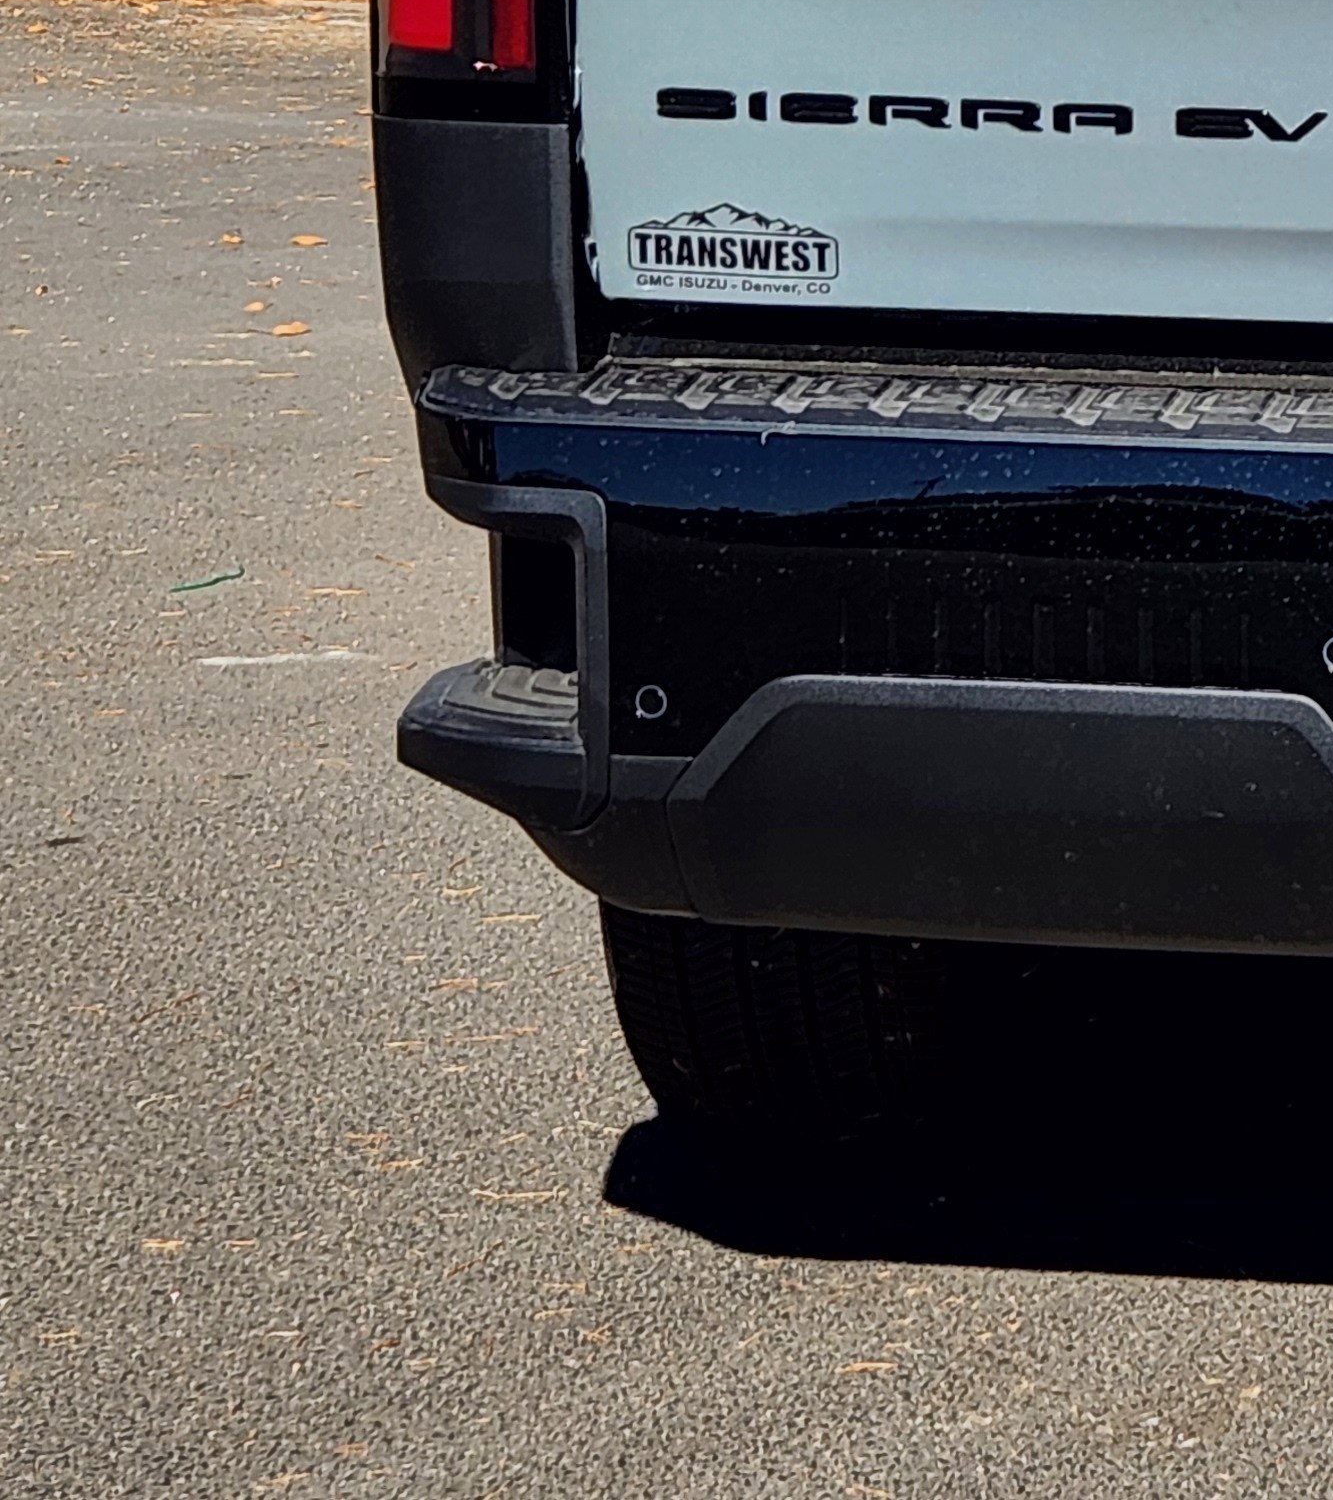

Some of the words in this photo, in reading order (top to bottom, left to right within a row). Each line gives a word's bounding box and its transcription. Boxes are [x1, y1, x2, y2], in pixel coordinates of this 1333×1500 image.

[655, 86, 1135, 136] SIERRA
[1174, 106, 1329, 142] EV
[634, 232, 831, 272] TRANSWEST
[636, 273, 674, 287] GMC
[678, 276, 728, 290] ISUZU
[741, 280, 801, 296] Denver,
[806, 282, 831, 295] CO
